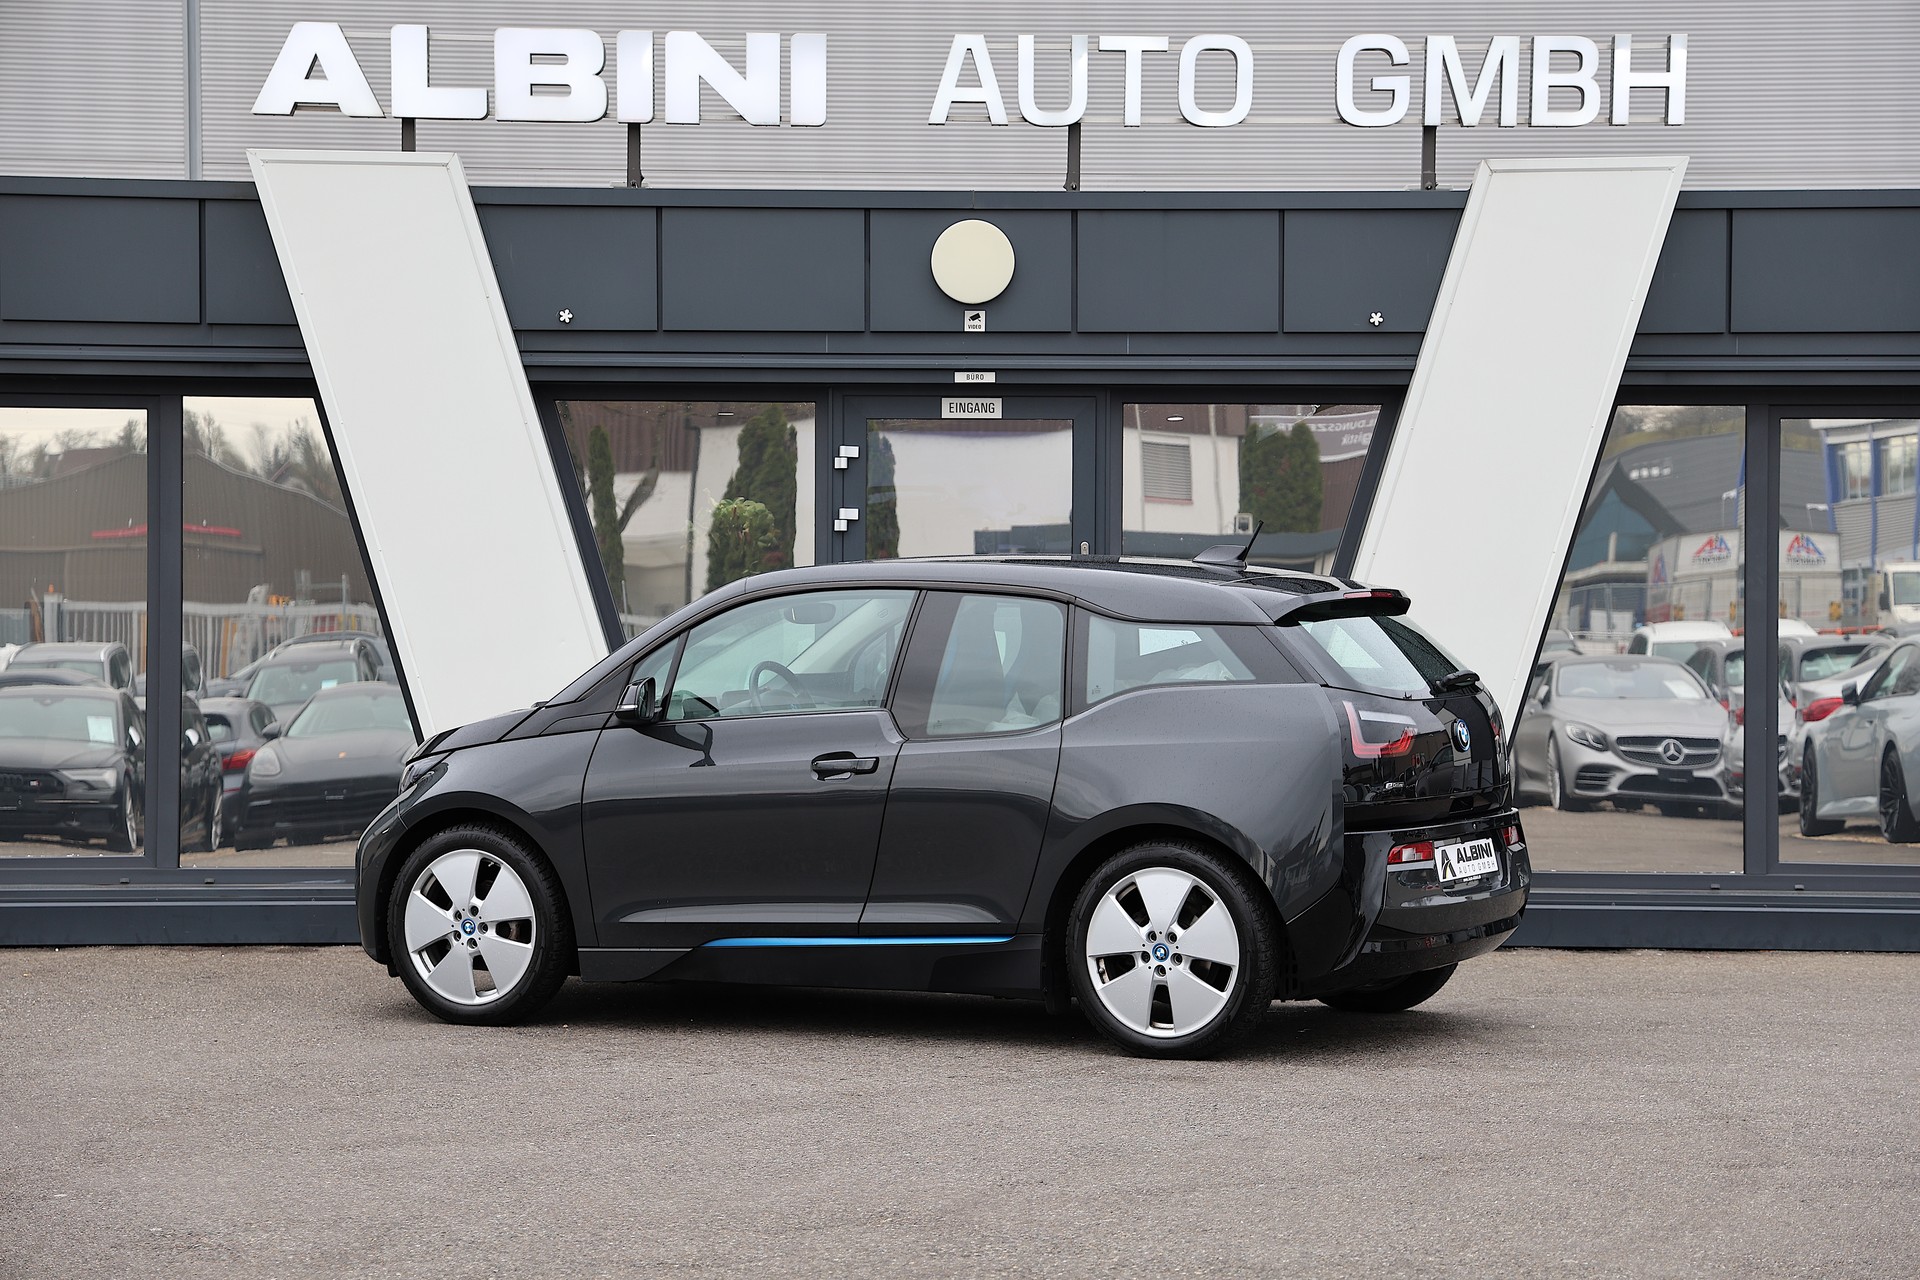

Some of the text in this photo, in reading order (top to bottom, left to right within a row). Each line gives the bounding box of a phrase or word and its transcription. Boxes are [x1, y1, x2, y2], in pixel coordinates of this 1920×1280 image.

[251, 21, 1689, 128] ALBINI AUTO GMBH
[966, 373, 985, 381] BÜRO
[948, 402, 996, 414] EINGANG
[1456, 842, 1493, 864] ALBINI
[1458, 859, 1496, 875] AUTO GMBH
